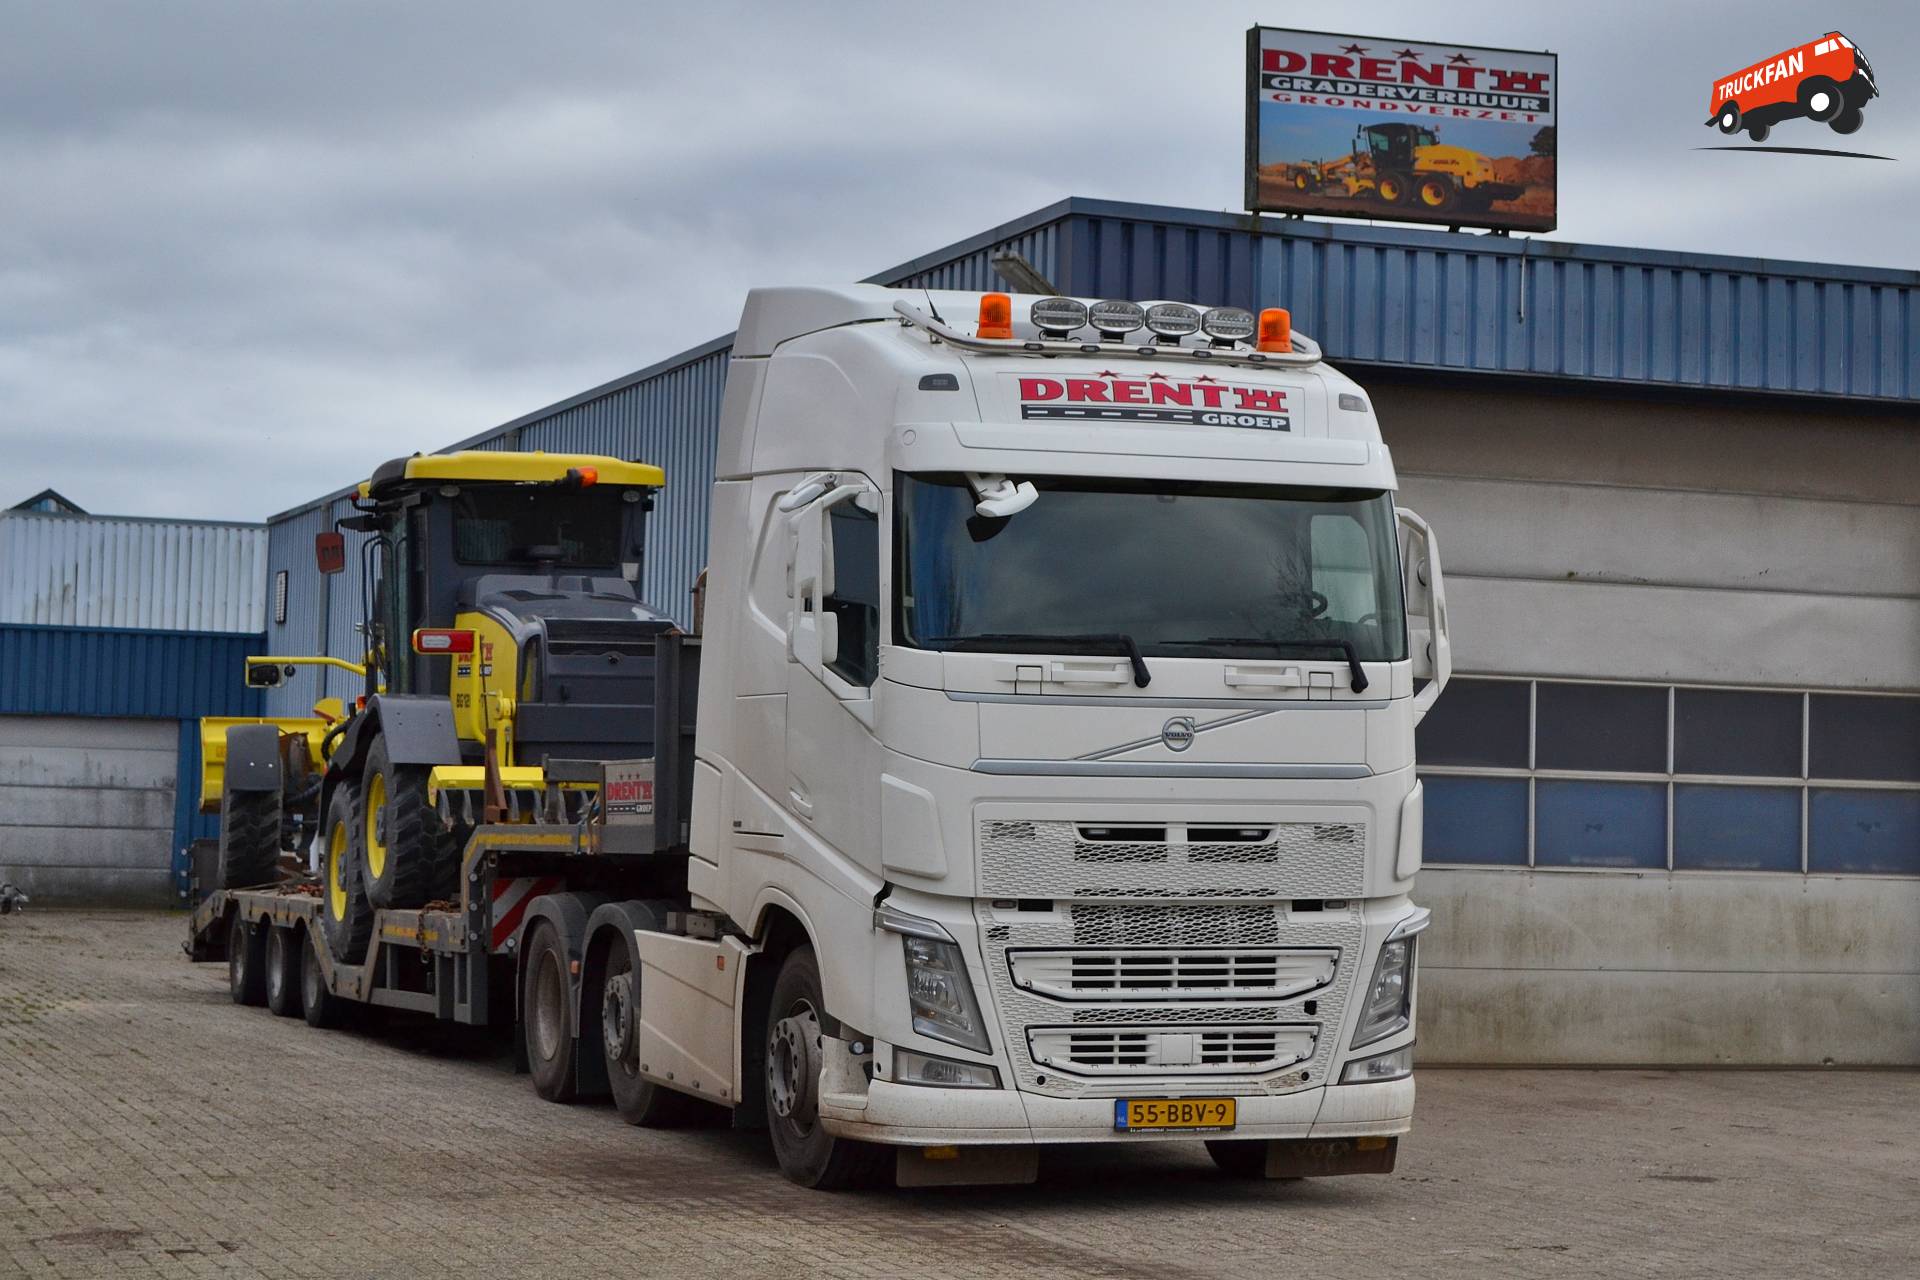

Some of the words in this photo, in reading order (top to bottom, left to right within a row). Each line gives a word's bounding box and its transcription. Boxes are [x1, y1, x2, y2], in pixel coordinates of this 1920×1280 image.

[1270, 77, 1541, 111] GRADERVERHUUR
[1272, 93, 1539, 123] GRONDVERZET
[1201, 413, 1288, 430] GROEP
[1133, 1103, 1227, 1123] 55-BBV-9
